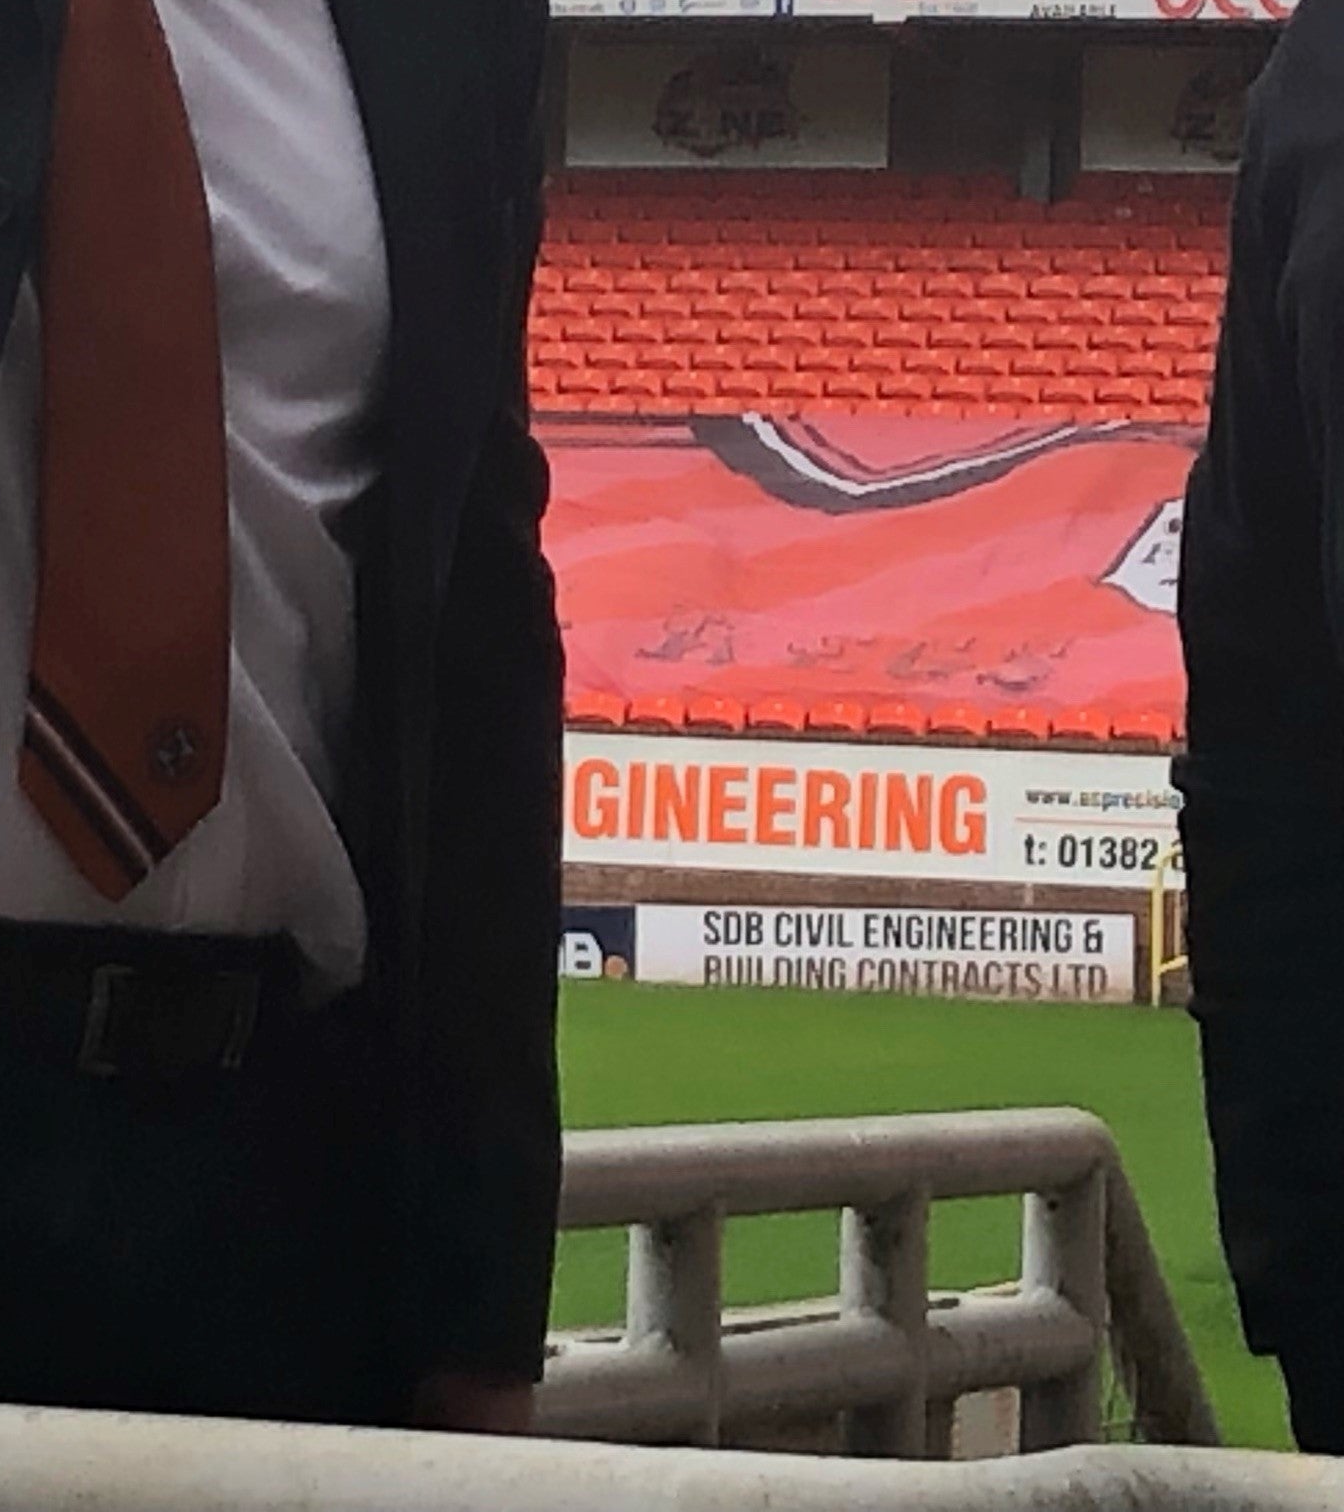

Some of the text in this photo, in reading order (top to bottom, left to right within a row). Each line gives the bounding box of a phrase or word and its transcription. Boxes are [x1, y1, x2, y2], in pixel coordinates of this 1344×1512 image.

[572, 756, 989, 856] GINEERING
[1058, 834, 1157, 871] 01382
[703, 910, 1104, 954] SDB CIVIL ENGINEERING &
[703, 954, 847, 989] BUILDING
[857, 957, 1042, 998] CONTRACTS
